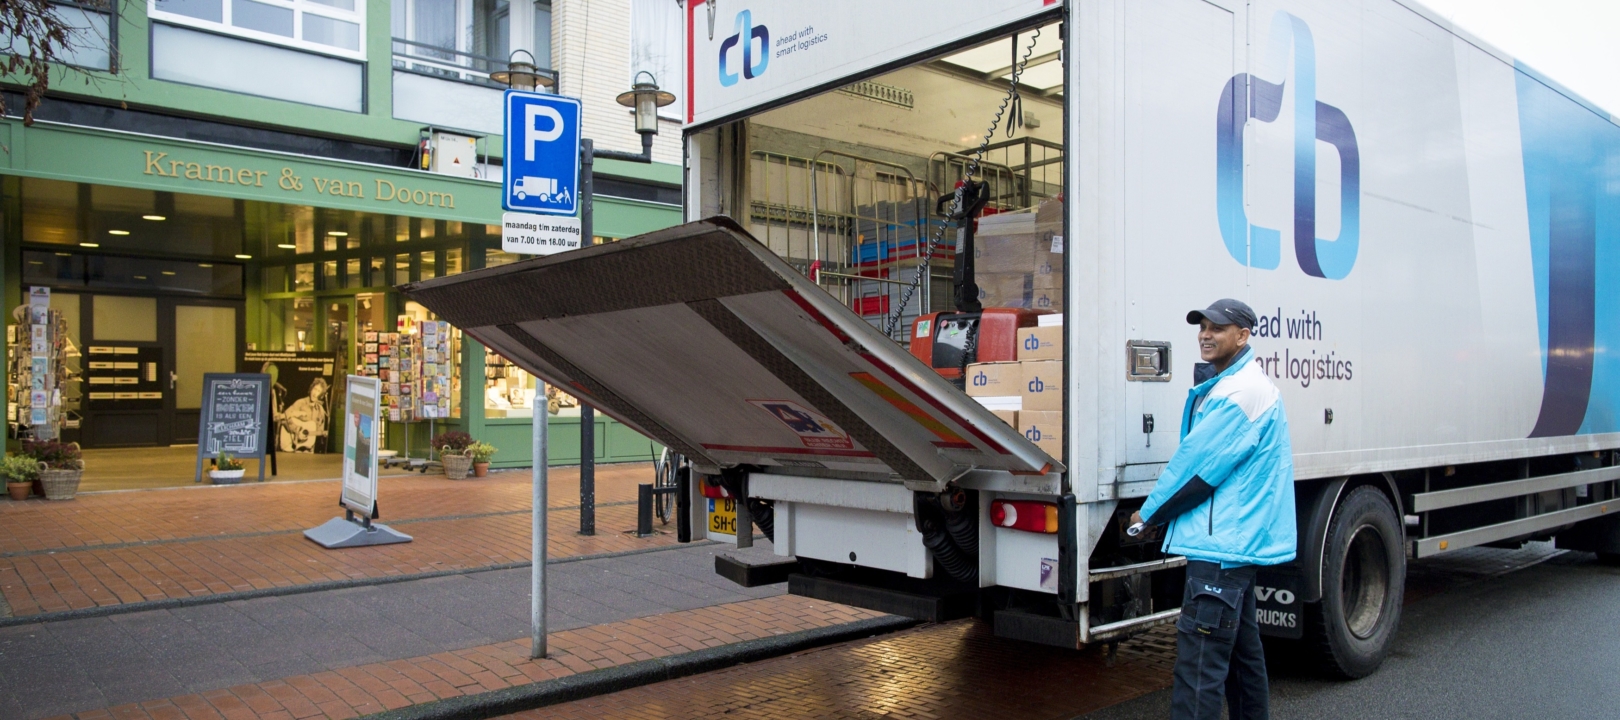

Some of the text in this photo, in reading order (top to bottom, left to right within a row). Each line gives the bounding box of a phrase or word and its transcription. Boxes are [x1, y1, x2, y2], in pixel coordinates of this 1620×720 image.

[776, 25, 814, 47] ahead with
[776, 33, 828, 58] smart logistics
[525, 103, 565, 162] P
[143, 150, 455, 208] Kramer & van Doorn
[505, 222, 537, 232] maandag
[551, 225, 580, 235] zaterdag
[520, 236, 535, 244] 7.00
[549, 238, 566, 246] 18.00
[1286, 309, 1322, 341] with
[1024, 333, 1039, 350] cb
[1286, 348, 1353, 388] logistics
[973, 371, 987, 386] cb
[1028, 376, 1044, 393] cb
[215, 403, 255, 413] BOEKEN
[1025, 425, 1041, 442] cb
[1256, 608, 1297, 628] RUCKS
